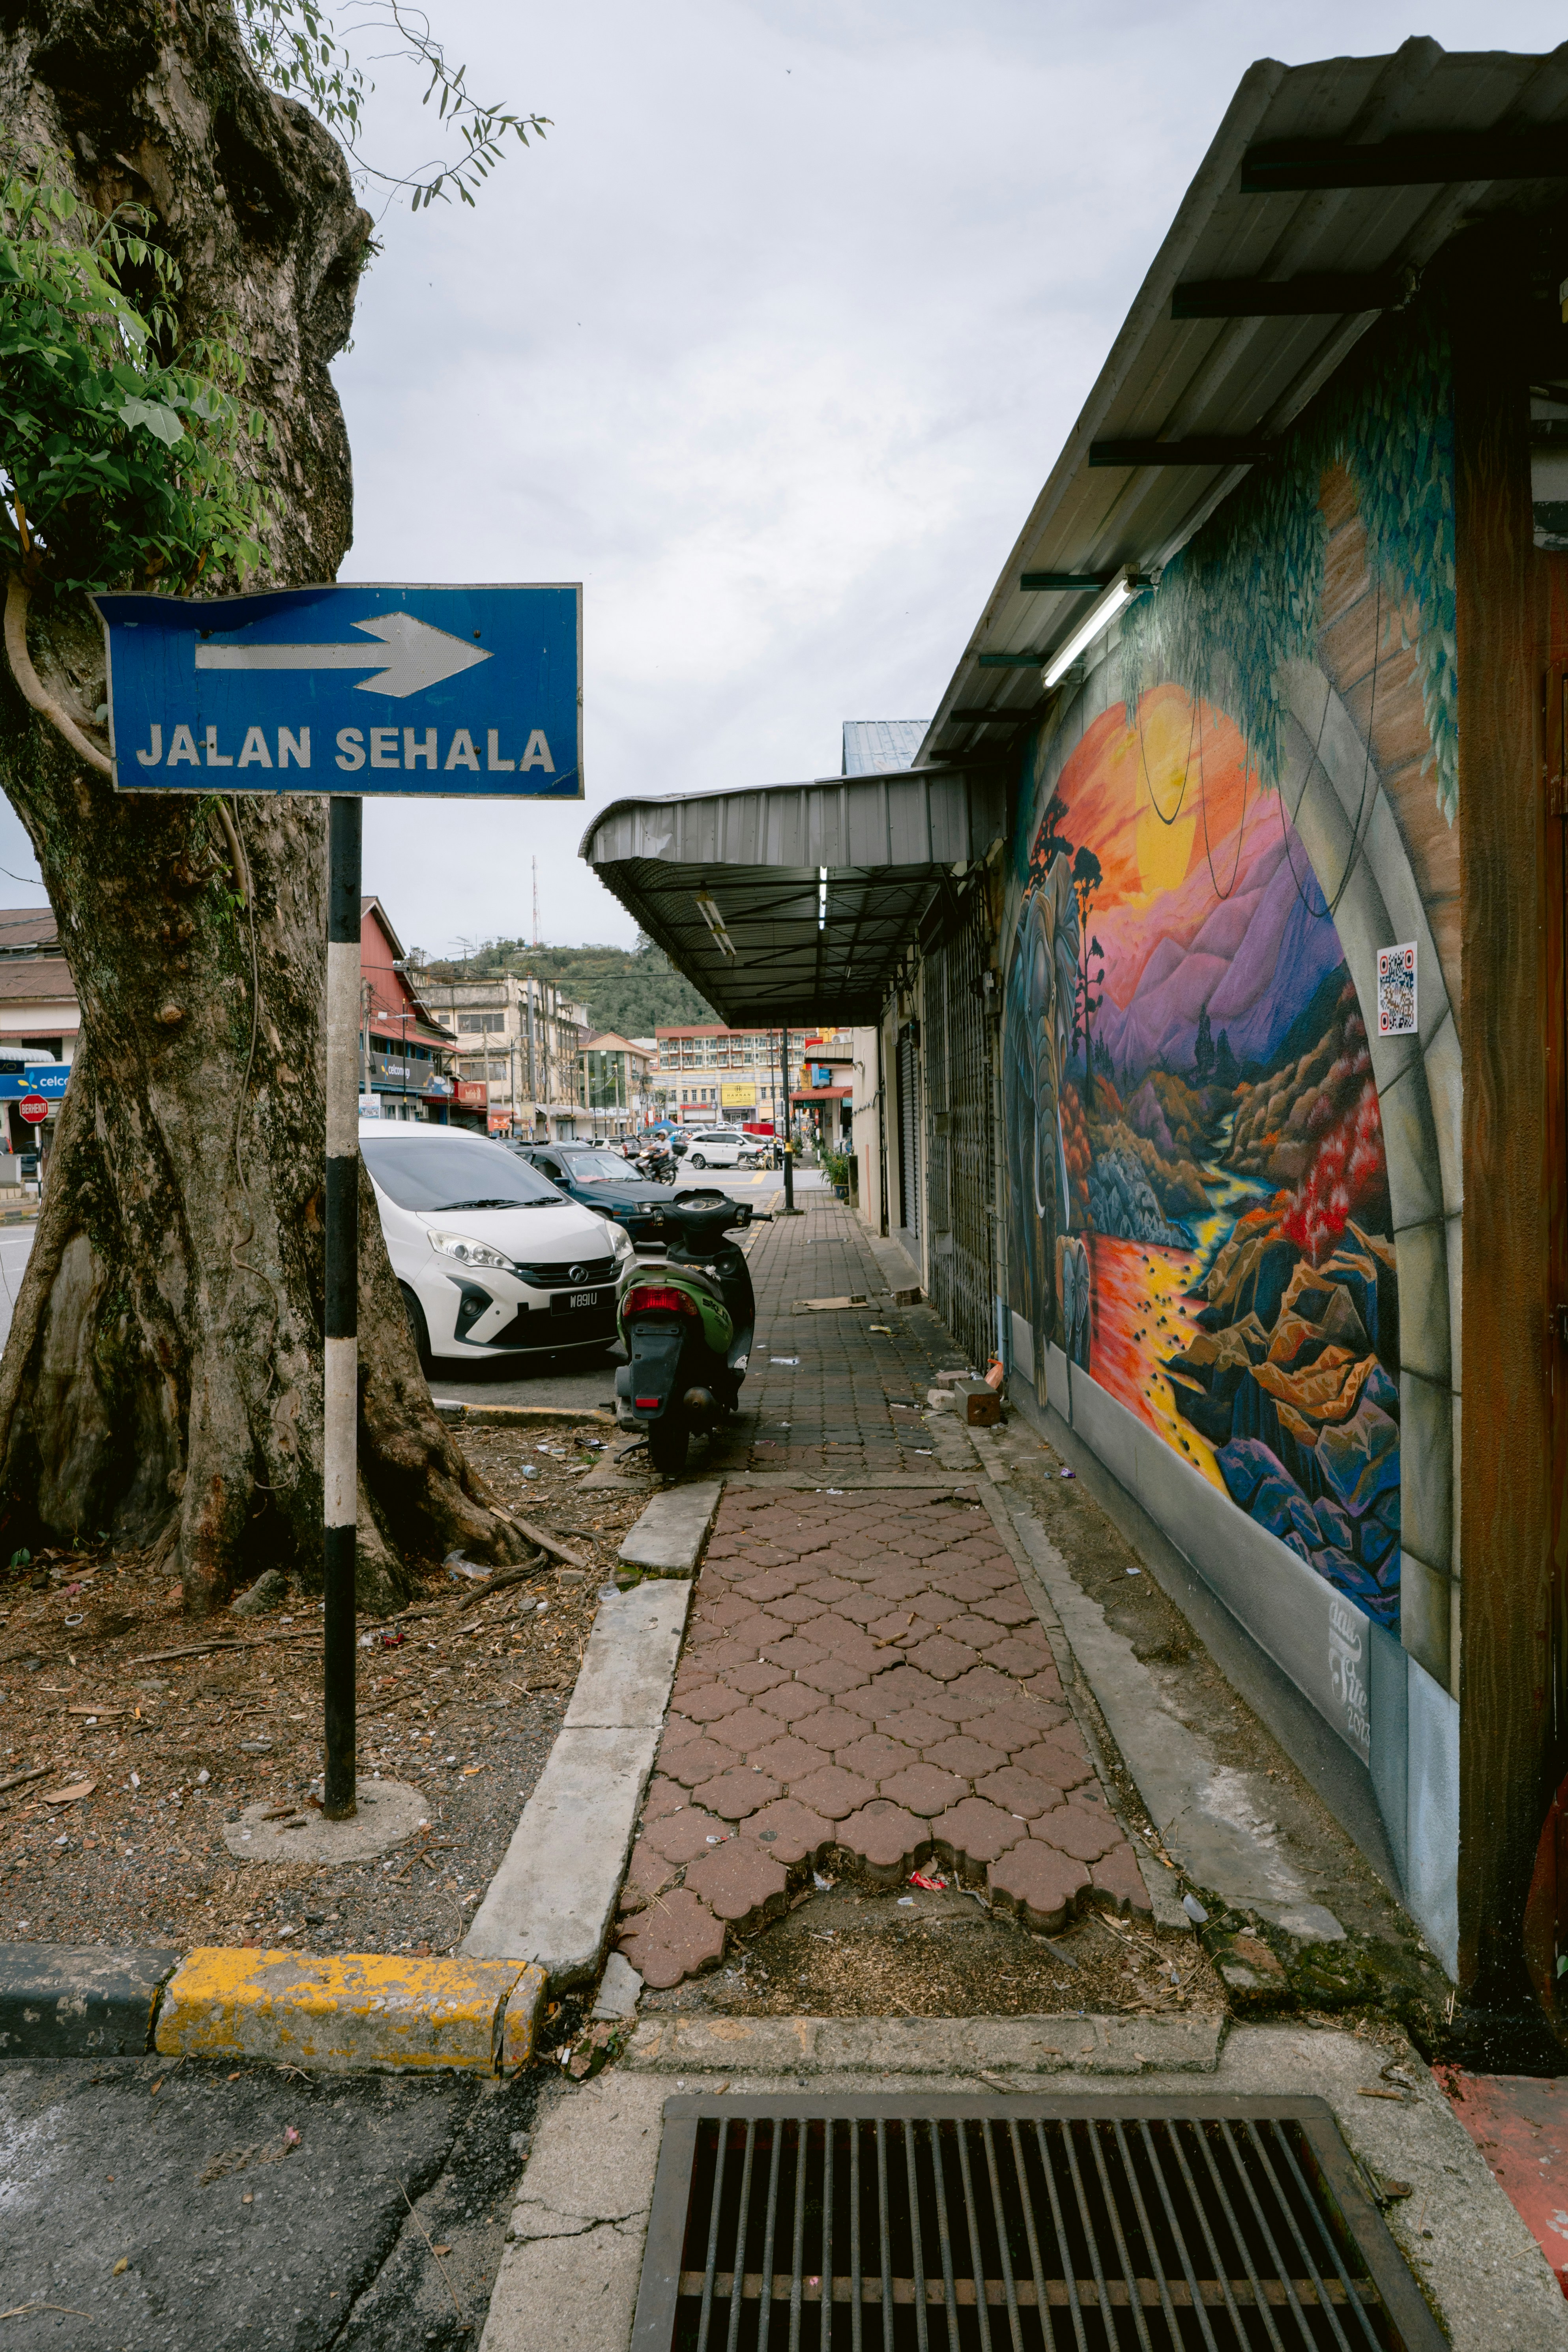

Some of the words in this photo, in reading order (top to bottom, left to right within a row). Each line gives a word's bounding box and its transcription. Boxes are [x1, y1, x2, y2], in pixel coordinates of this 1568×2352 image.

[136, 724, 311, 769] JALAN
[335, 727, 556, 773] SEHALA
[21, 1102, 47, 1114] BERHENTI
[570, 1292, 597, 1308] W891U
[1347, 1706, 1370, 1748] 2023
